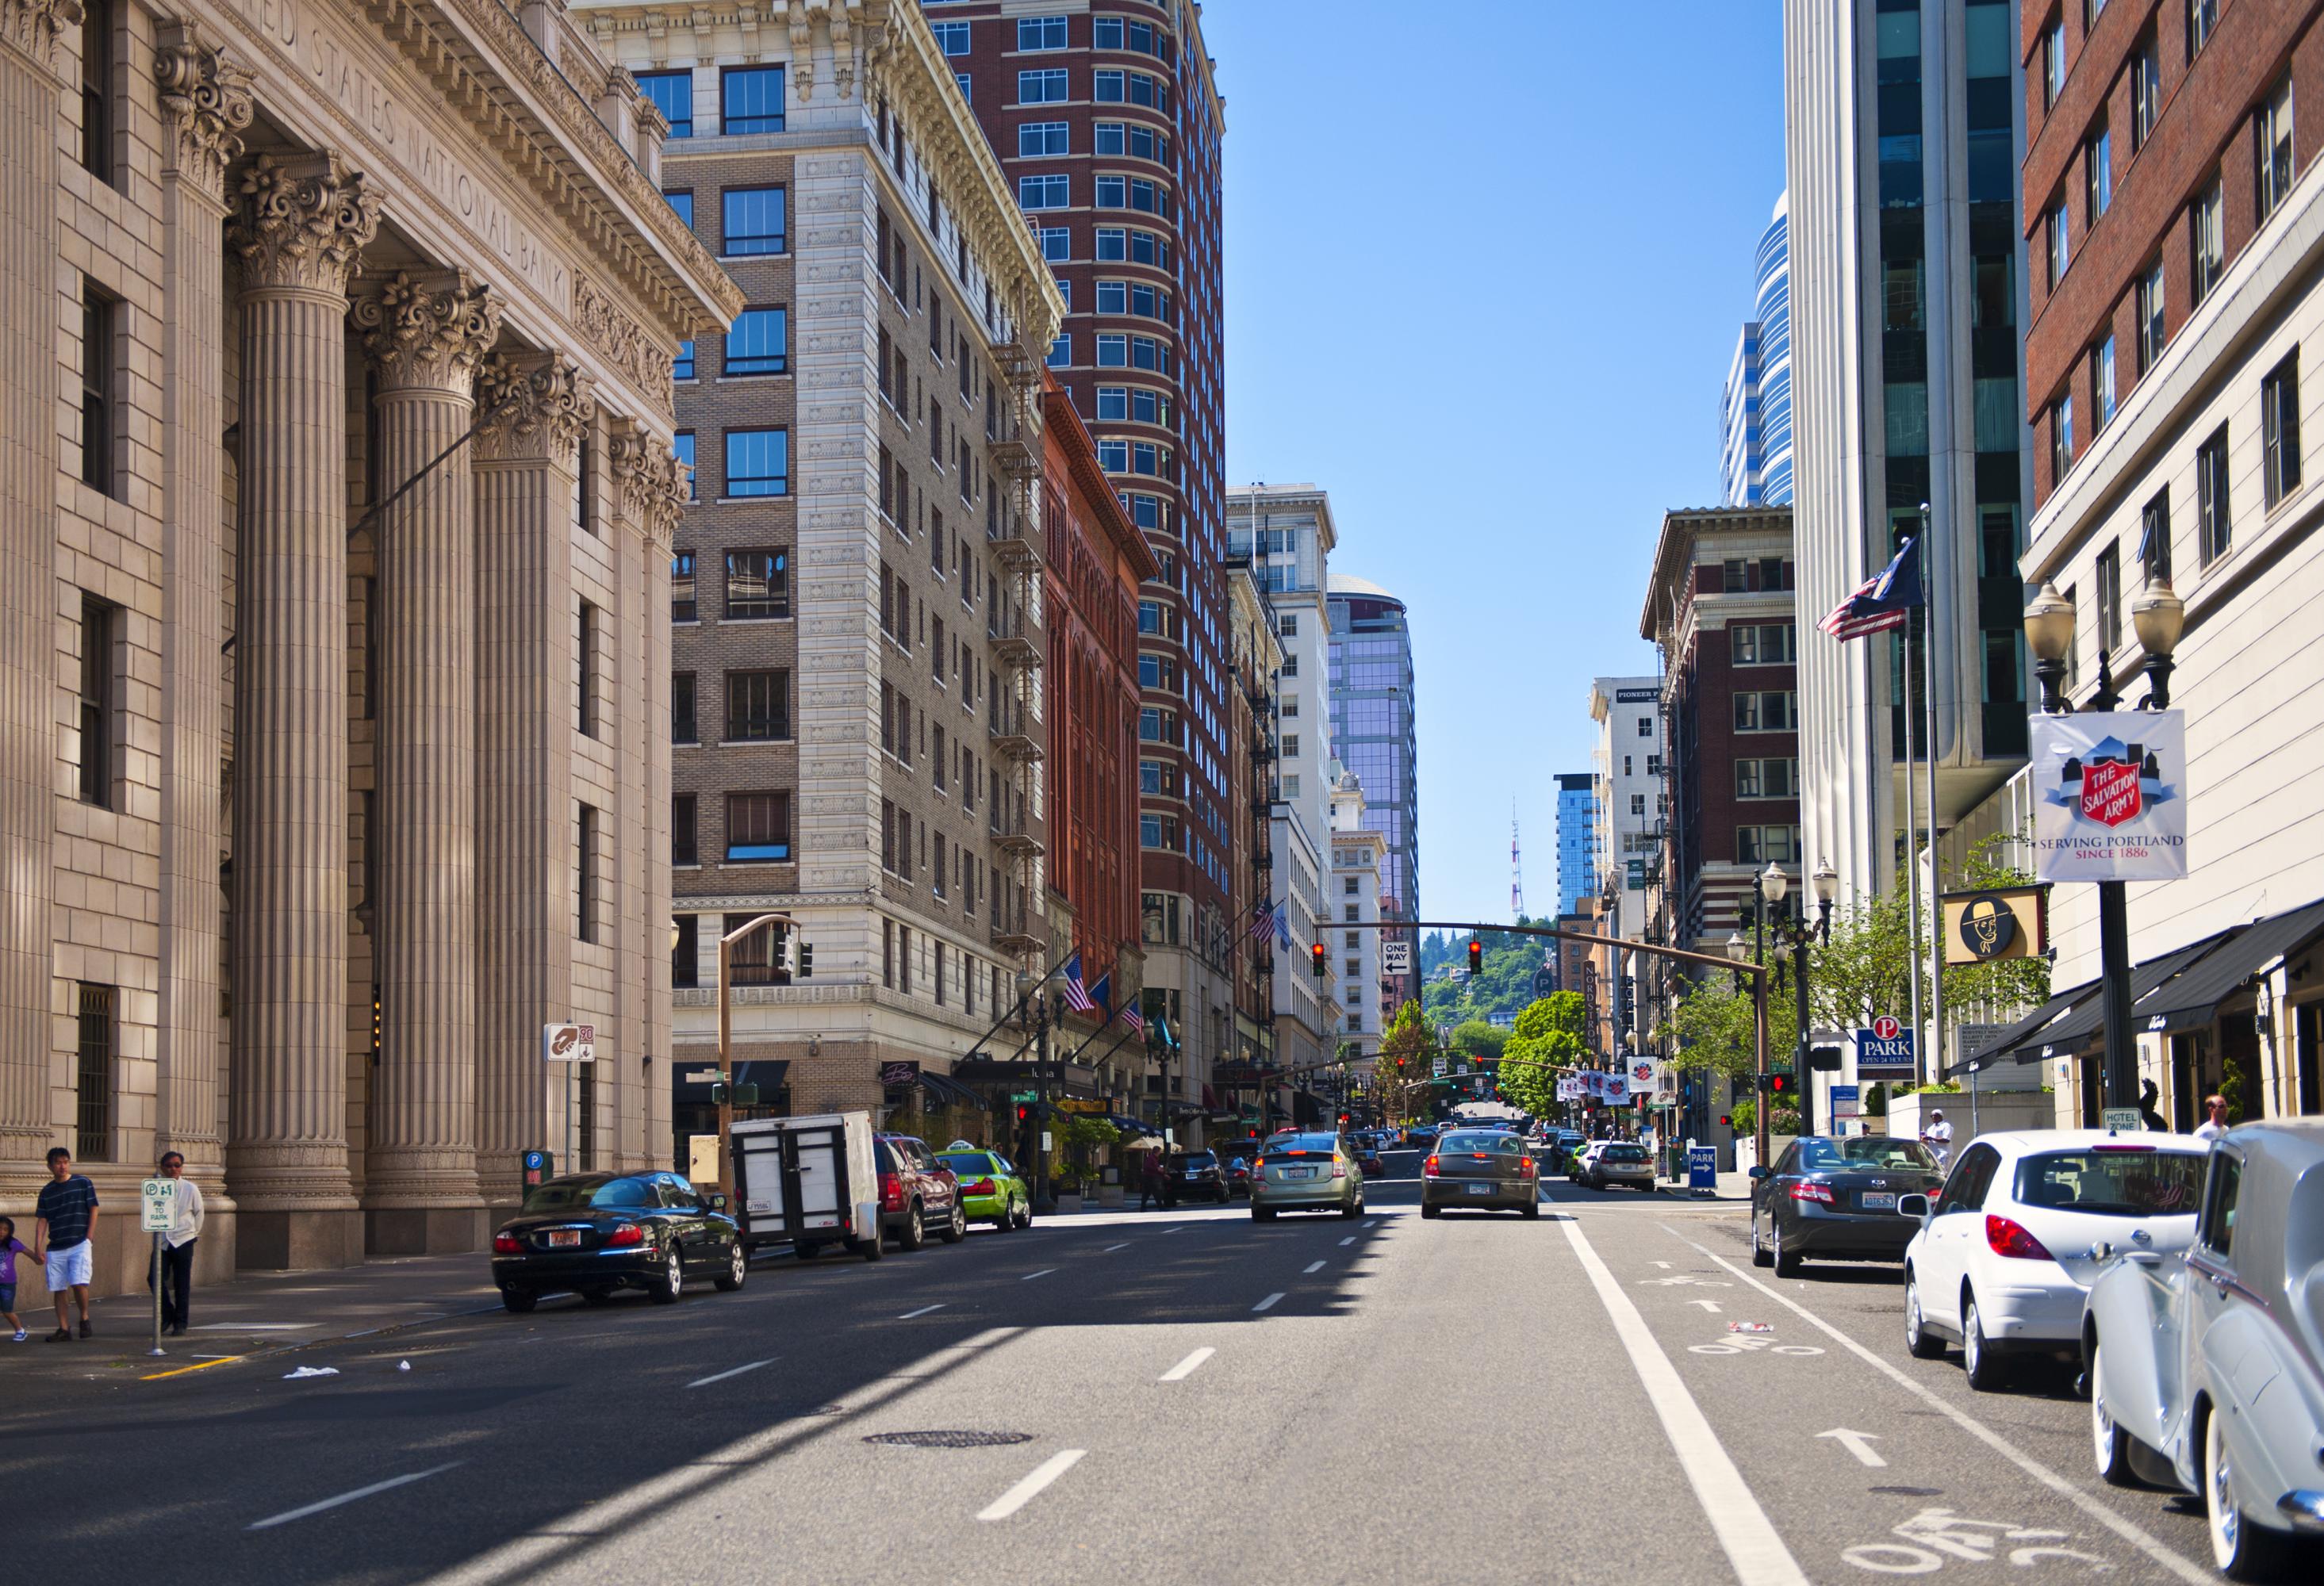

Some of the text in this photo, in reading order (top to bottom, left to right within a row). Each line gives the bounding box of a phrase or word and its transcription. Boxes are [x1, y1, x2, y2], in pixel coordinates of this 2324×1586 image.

[310, 29, 395, 144] STATES
[408, 127, 512, 258] NATIONAL
[520, 232, 566, 308] BANK
[2092, 766, 2116, 789] THE
[2084, 769, 2136, 813] SALVATION
[2103, 789, 2135, 821] ARMY
[2040, 835, 2184, 849] SERVING PORTLAND
[2076, 848, 2148, 859] SINCE 1886
[1586, 967, 1596, 1046] NORDSTROM
[580, 1028, 593, 1040] 90
[1881, 1019, 1895, 1037] P
[1864, 1041, 1911, 1055] PARK
[2107, 1113, 2137, 1122] HOTEL
[531, 1155, 538, 1166] P
[1691, 1154, 1714, 1163] PARK
